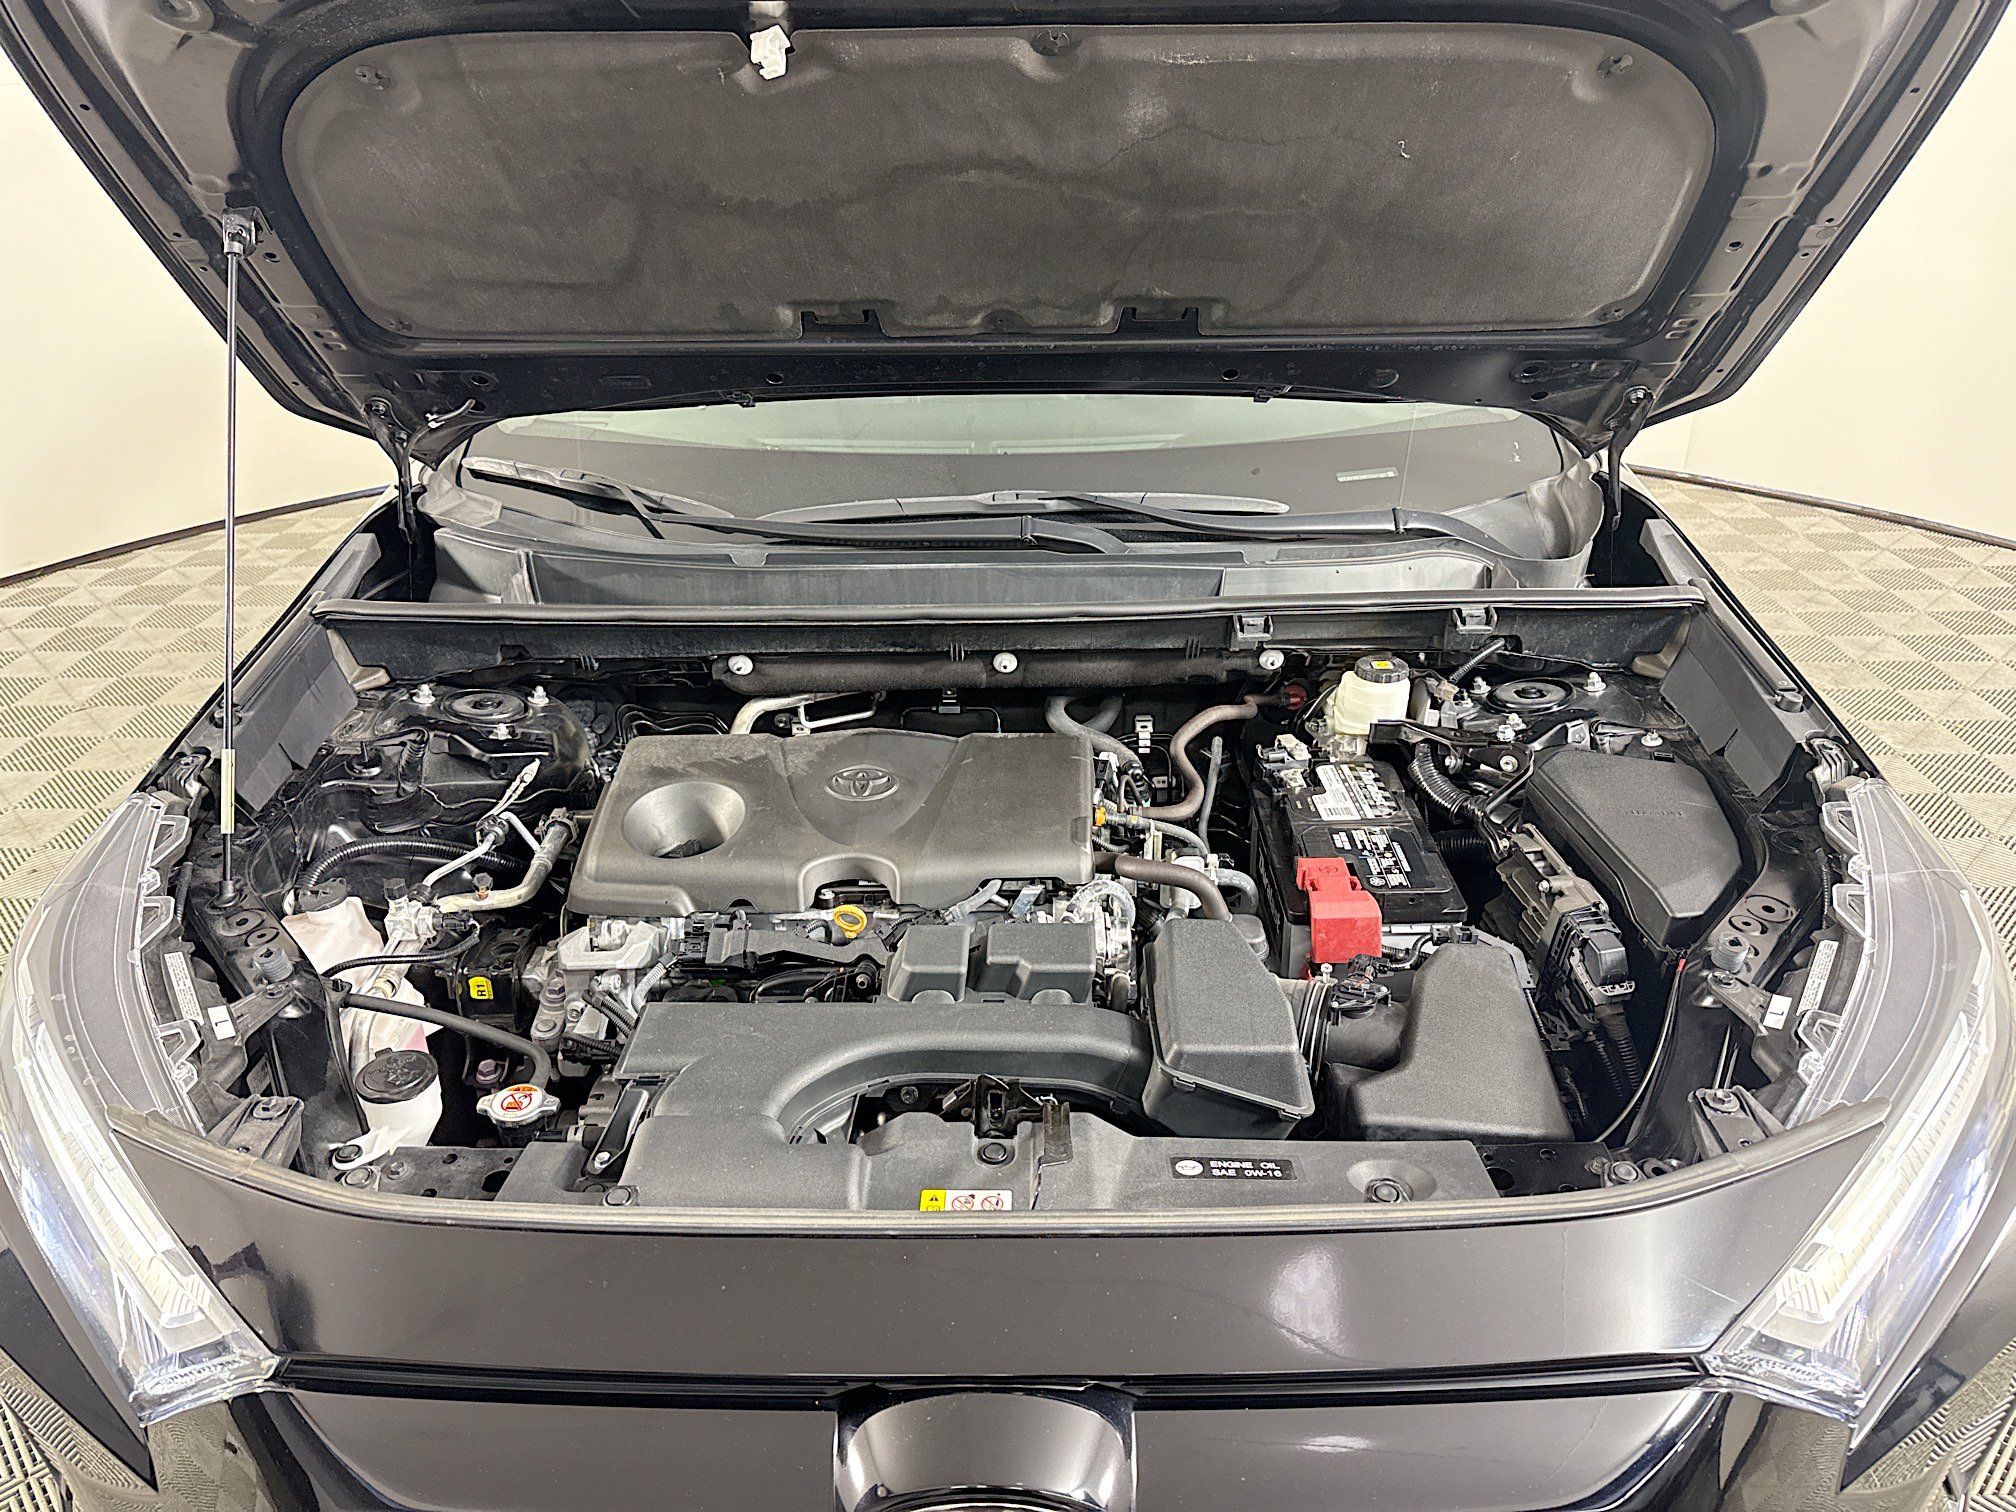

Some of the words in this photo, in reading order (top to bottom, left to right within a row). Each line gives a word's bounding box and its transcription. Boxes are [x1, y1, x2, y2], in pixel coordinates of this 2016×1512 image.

[476, 984, 486, 997] R1
[1209, 1160, 1254, 1169] ENGINE
[1260, 1161, 1281, 1170] OIL
[1211, 1169, 1237, 1177] SAE
[1244, 1169, 1283, 1177] 0W-16
